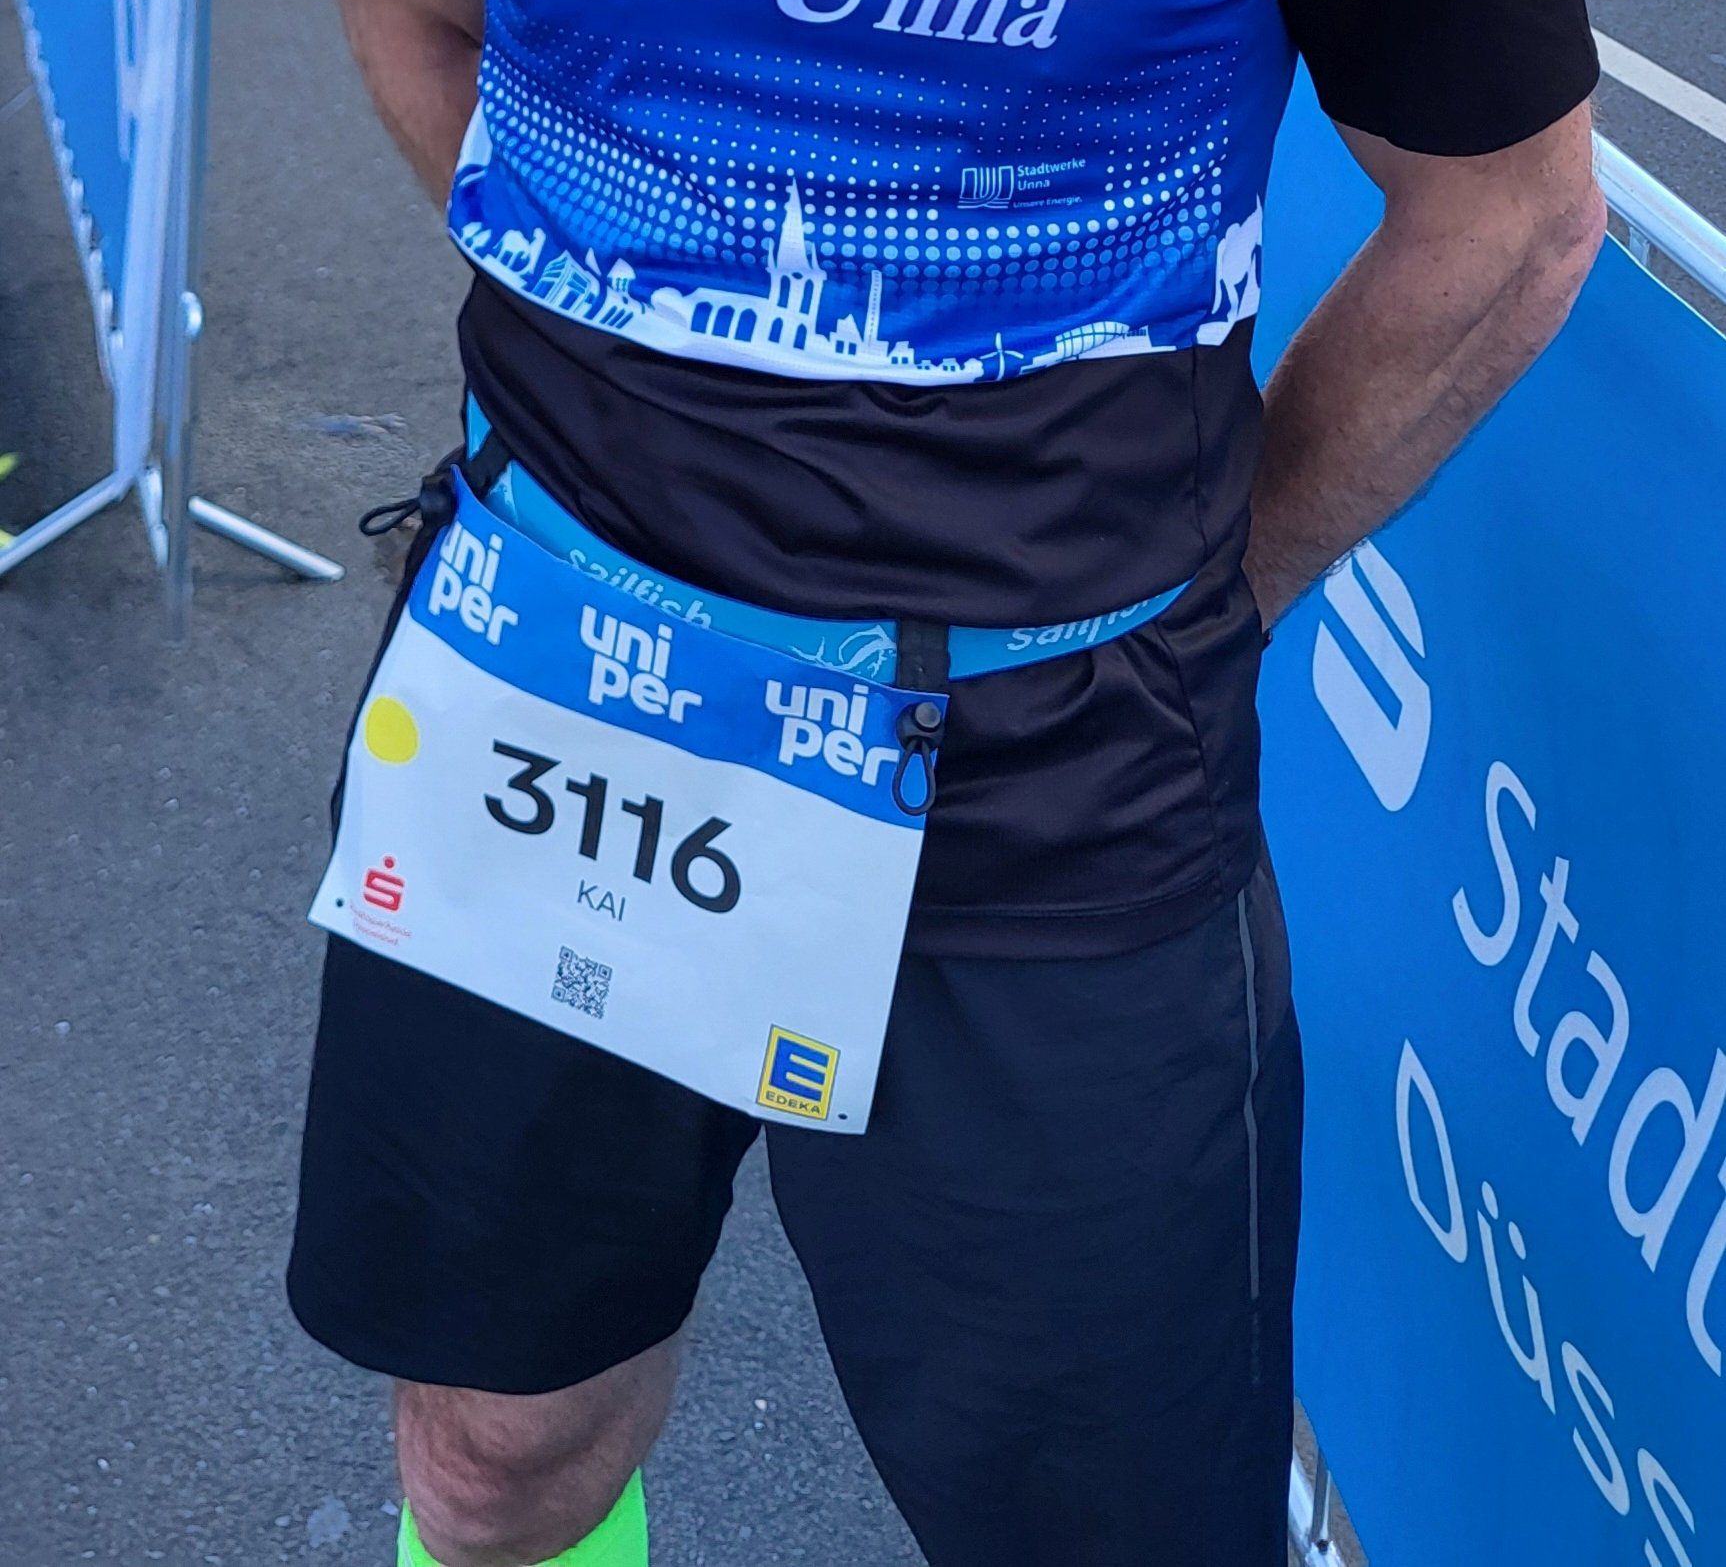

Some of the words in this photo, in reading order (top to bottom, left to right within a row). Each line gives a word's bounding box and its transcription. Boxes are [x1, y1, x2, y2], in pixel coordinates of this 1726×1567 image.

[1017, 157, 1087, 178] Stadtwerke
[1017, 179, 1051, 192] Unna
[427, 559, 519, 647] per
[580, 604, 673, 680] uni
[587, 651, 703, 724] per
[764, 679, 870, 736] uni
[778, 716, 900, 787] per
[484, 739, 742, 914] 3116
[577, 879, 626, 922] KAI
[765, 1090, 821, 1114] EDEKA
